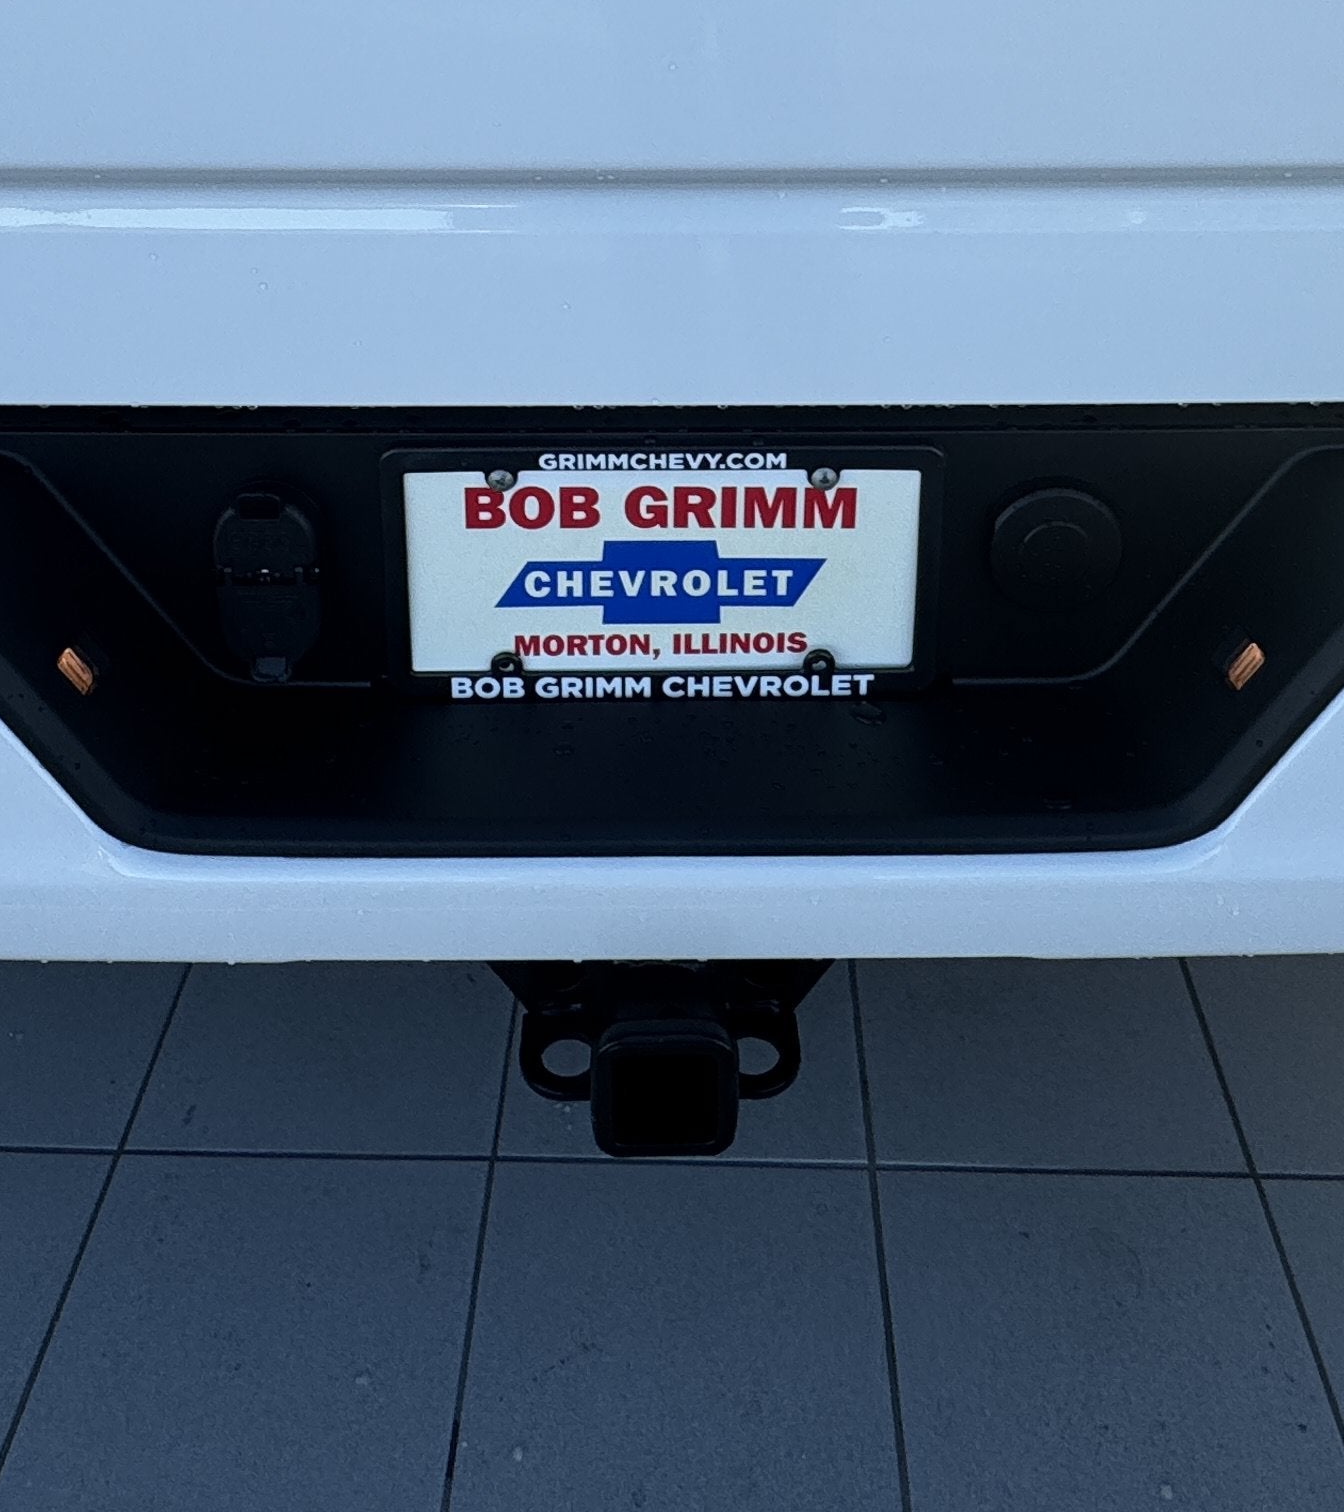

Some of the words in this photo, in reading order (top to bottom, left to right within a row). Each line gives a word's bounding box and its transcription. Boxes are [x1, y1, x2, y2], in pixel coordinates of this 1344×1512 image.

[538, 452, 788, 470] GRIMMCHEVY.COM
[464, 486, 600, 529] BOB
[624, 486, 857, 530] GRIMM
[523, 569, 794, 598] CHEVROLET
[514, 633, 661, 659] MORTON,
[672, 631, 808, 655] ILLINOIS
[451, 676, 525, 699] BOB
[535, 676, 652, 699] GRIMM
[662, 673, 875, 698] CHEVROLET
